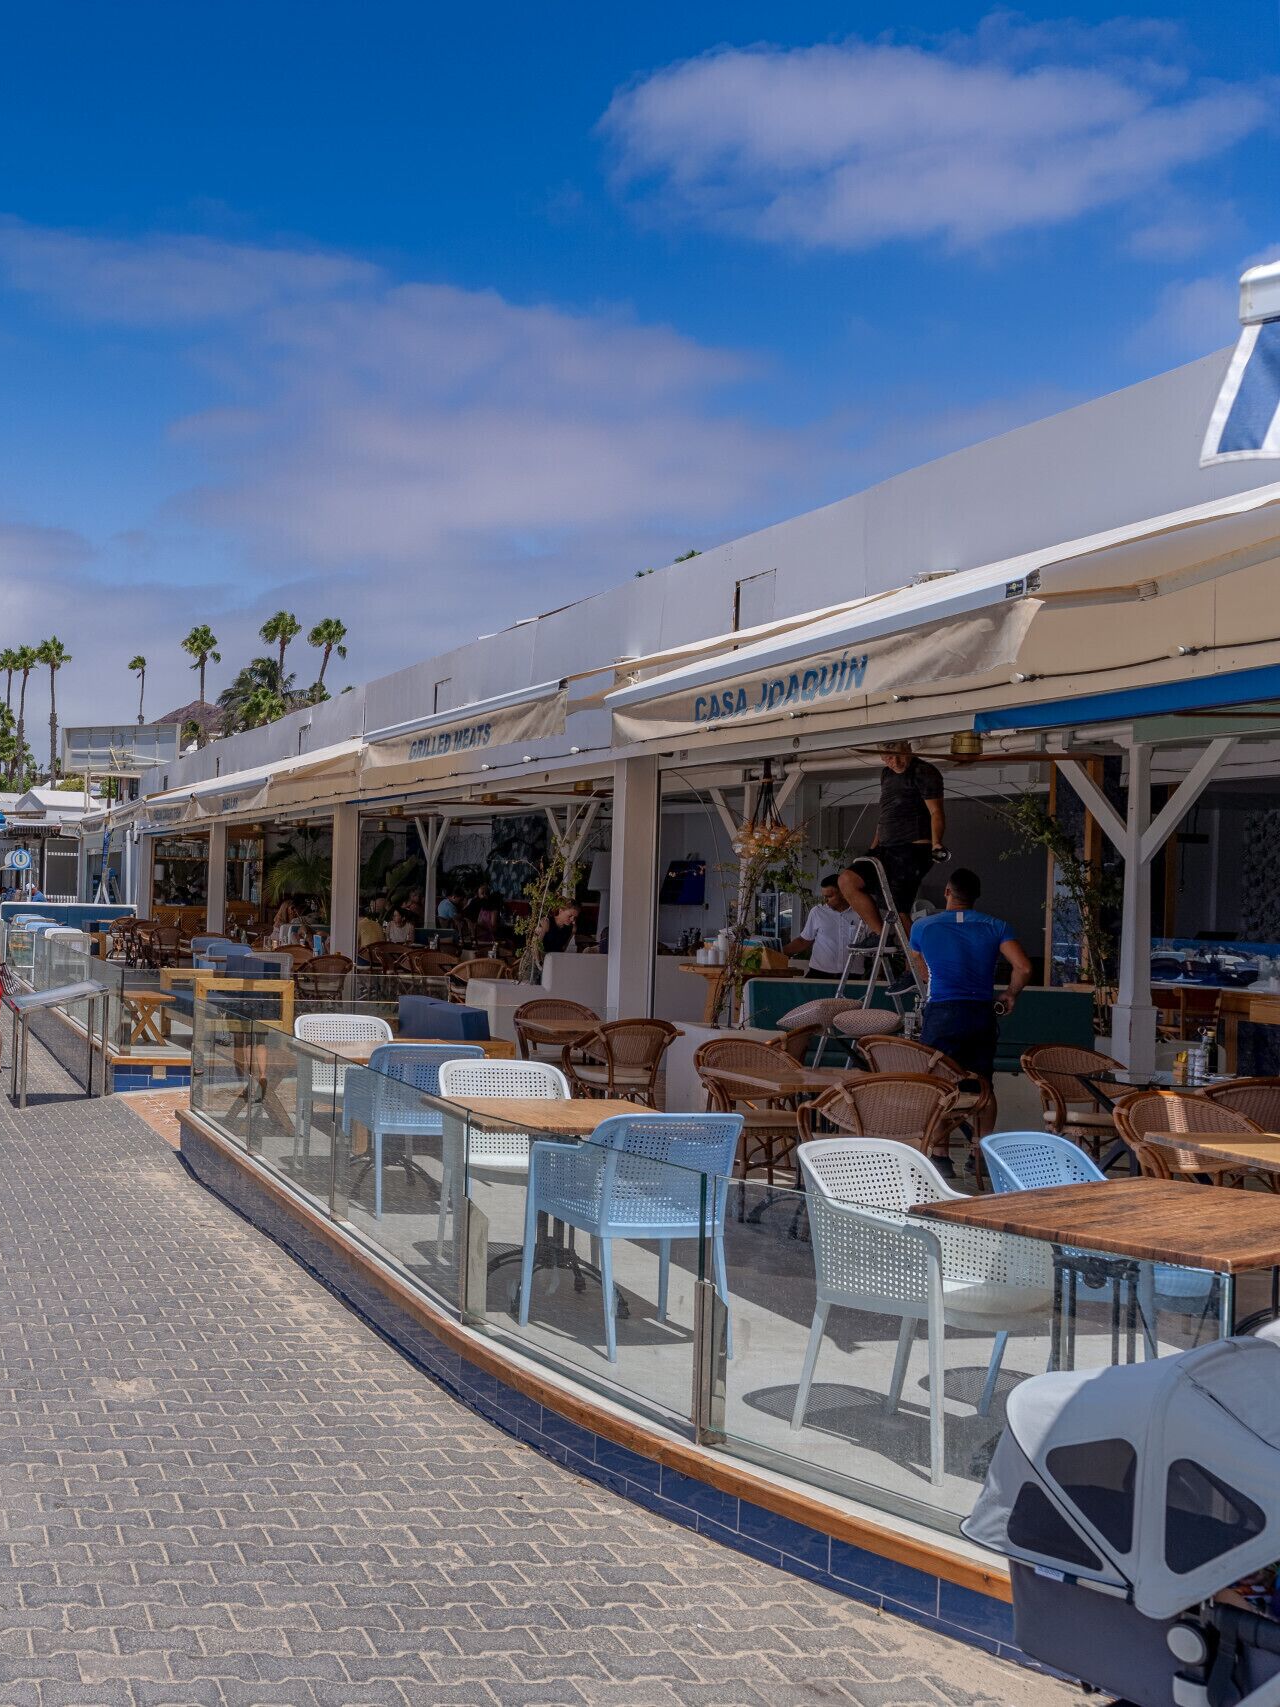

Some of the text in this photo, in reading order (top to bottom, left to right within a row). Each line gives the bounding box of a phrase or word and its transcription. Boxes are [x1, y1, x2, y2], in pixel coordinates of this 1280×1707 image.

[694, 650, 869, 724] CASA JOAQUÍN
[408, 723, 492, 760] GRILLED MEATS
